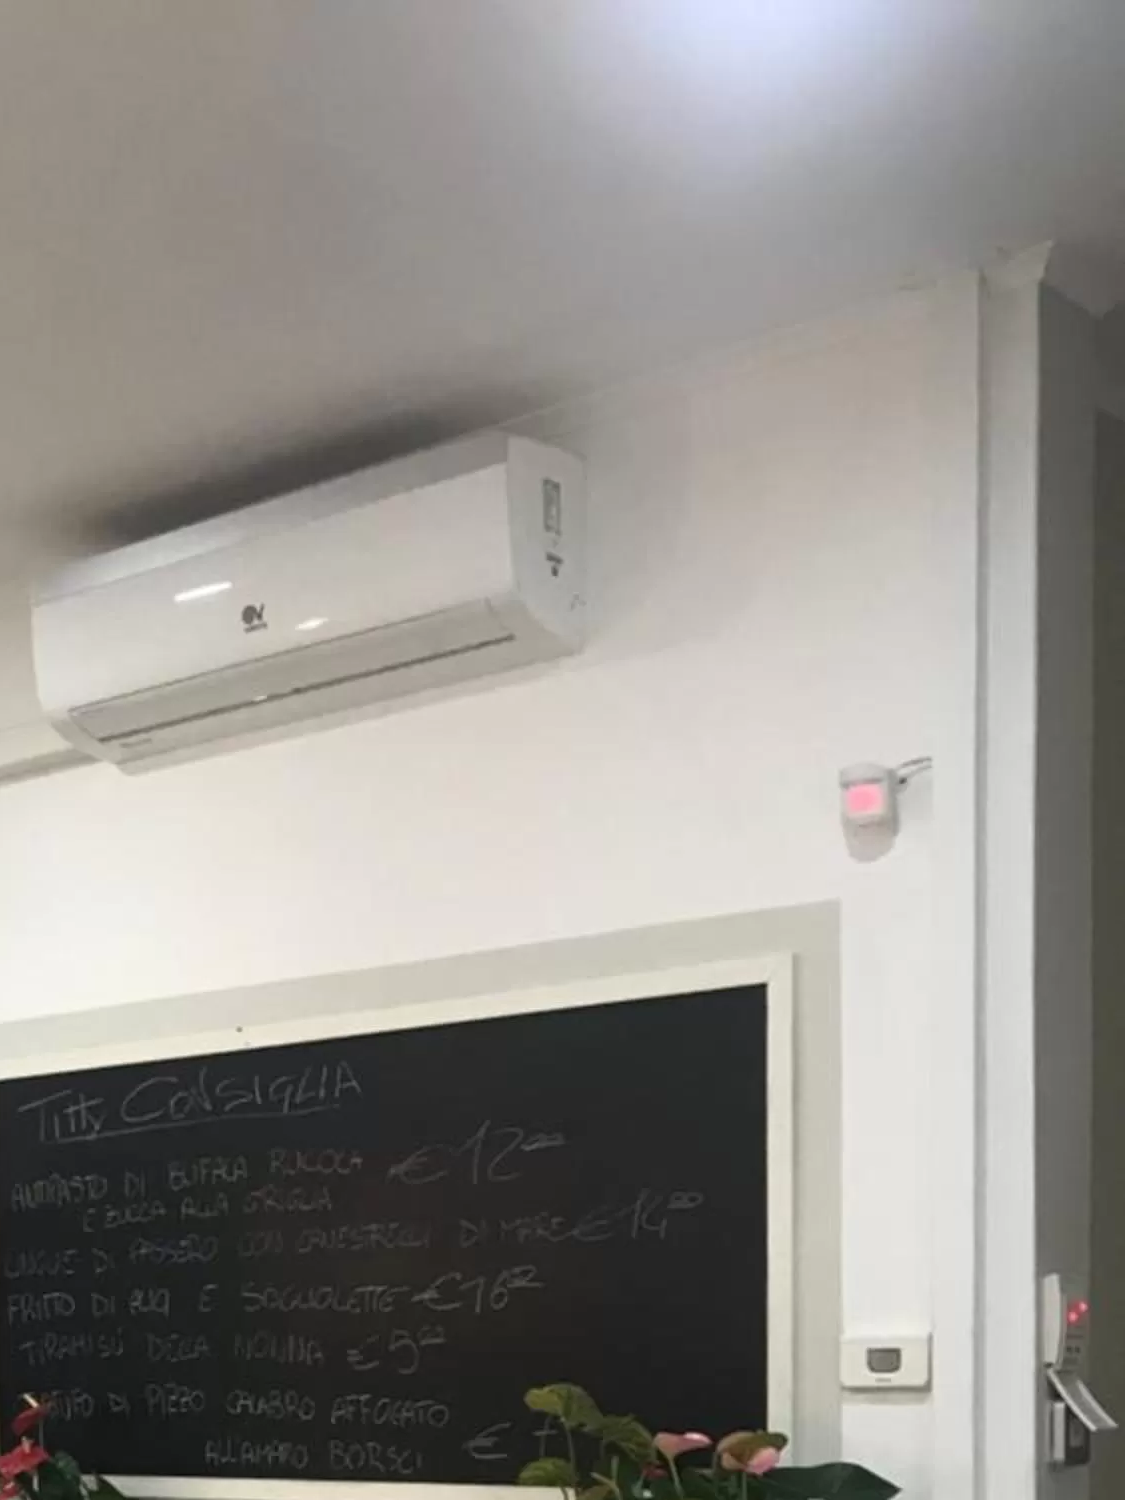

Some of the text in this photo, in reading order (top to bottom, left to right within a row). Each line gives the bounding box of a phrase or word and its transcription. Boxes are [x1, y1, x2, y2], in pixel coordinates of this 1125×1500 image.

[123, 1168, 148, 1199] DI
[91, 1246, 116, 1276] DI
[458, 1218, 487, 1249] DI
[90, 1290, 116, 1318] DI
[198, 1283, 219, 1312] E
